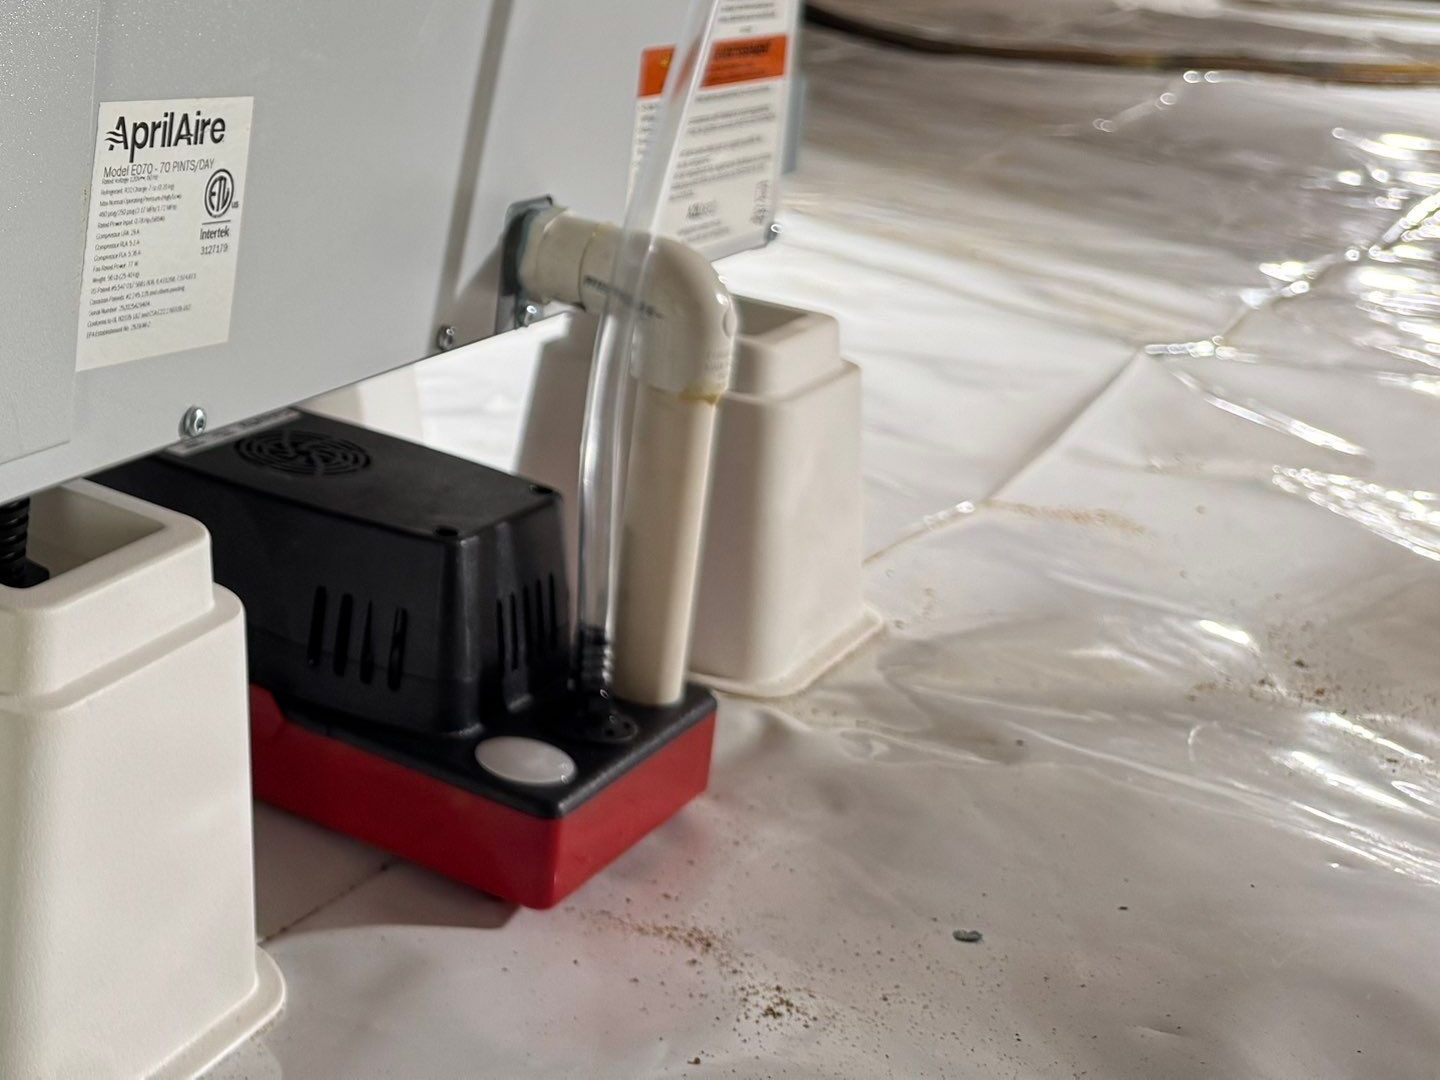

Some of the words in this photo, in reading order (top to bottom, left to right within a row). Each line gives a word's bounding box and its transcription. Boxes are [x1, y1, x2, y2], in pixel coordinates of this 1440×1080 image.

[105, 110, 226, 163] AprilAire
[103, 166, 129, 178] Model
[160, 162, 170, 173] 70
[172, 158, 215, 172] PINTS/DAY
[200, 225, 229, 240] Intertek
